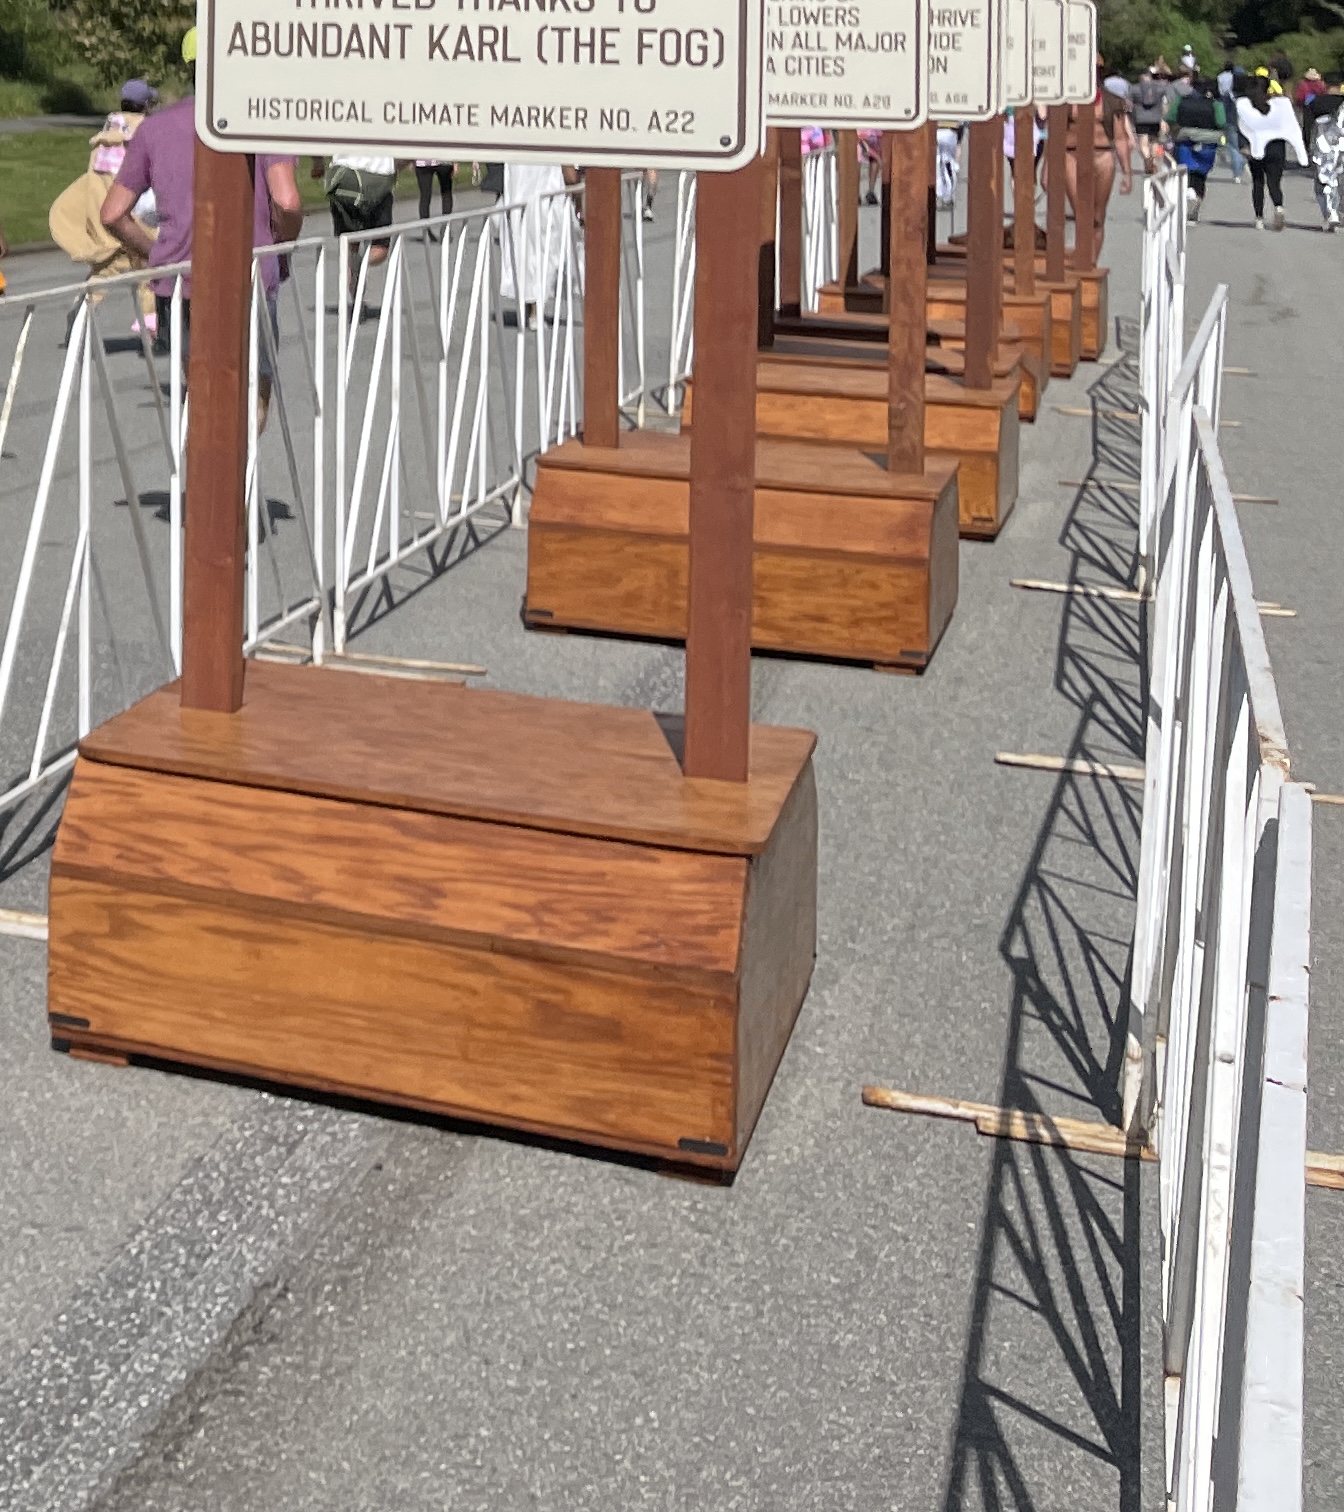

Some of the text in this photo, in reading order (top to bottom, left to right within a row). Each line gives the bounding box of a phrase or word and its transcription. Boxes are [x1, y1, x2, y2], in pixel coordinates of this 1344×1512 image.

[778, 6, 859, 27] LOWERS
[929, 9, 981, 28] HRIVE
[227, 21, 725, 68] ABUNDANT KARL (THE FOG)
[791, 32, 827, 52] ALL
[835, 32, 906, 52] MAJOR
[929, 32, 962, 51] IDE
[785, 56, 845, 76] CITIES
[248, 97, 695, 134] HISTORICAL CLIMATE MARKER NO. A22
